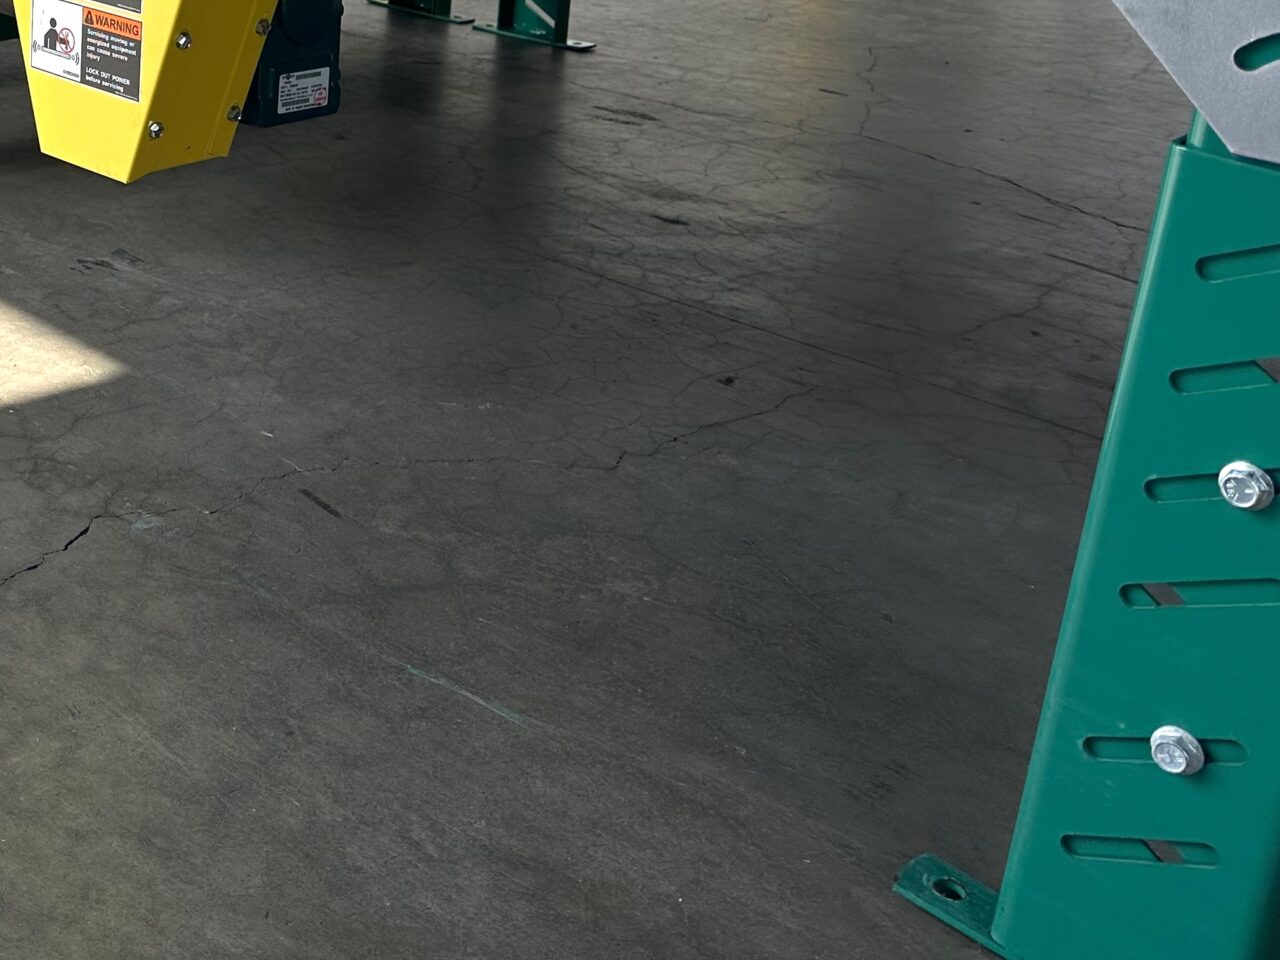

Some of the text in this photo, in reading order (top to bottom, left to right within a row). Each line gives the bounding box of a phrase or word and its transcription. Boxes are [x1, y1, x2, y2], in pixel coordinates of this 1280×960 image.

[95, 15, 139, 36] WARNING
[87, 28, 109, 41] Servicing
[85, 66, 99, 76] LOCK
[100, 71, 111, 79] OUT
[112, 74, 131, 86] POWER
[102, 79, 124, 92] servicing
